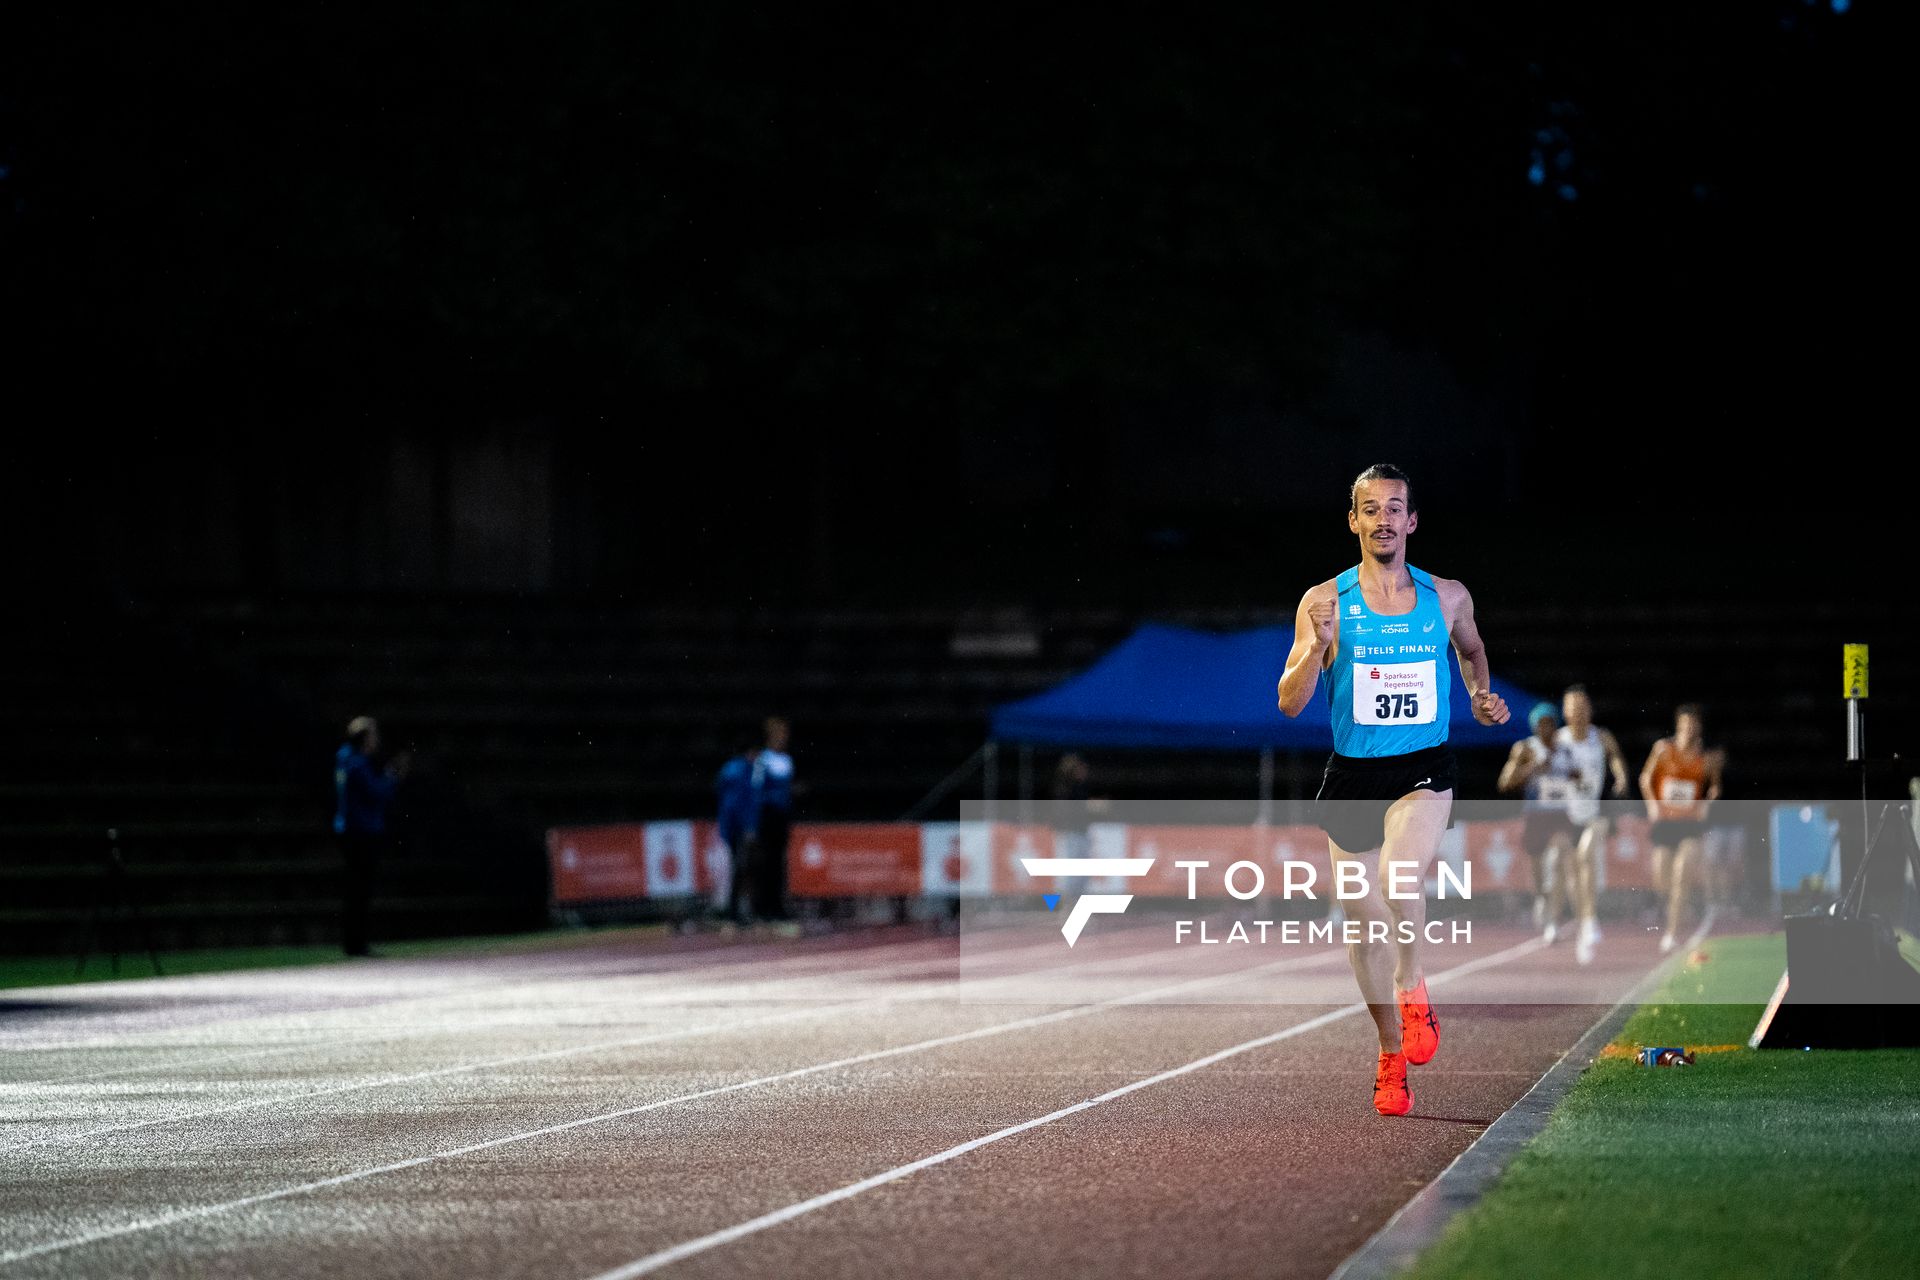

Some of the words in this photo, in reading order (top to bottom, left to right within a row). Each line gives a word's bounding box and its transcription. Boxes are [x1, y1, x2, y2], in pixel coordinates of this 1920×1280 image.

[1367, 646, 1395, 655] TELIS
[1399, 645, 1437, 654] FINANZ
[1384, 672, 1418, 681] Sparkasse
[1384, 681, 1424, 690] Regensburg
[1375, 693, 1419, 719] 375
